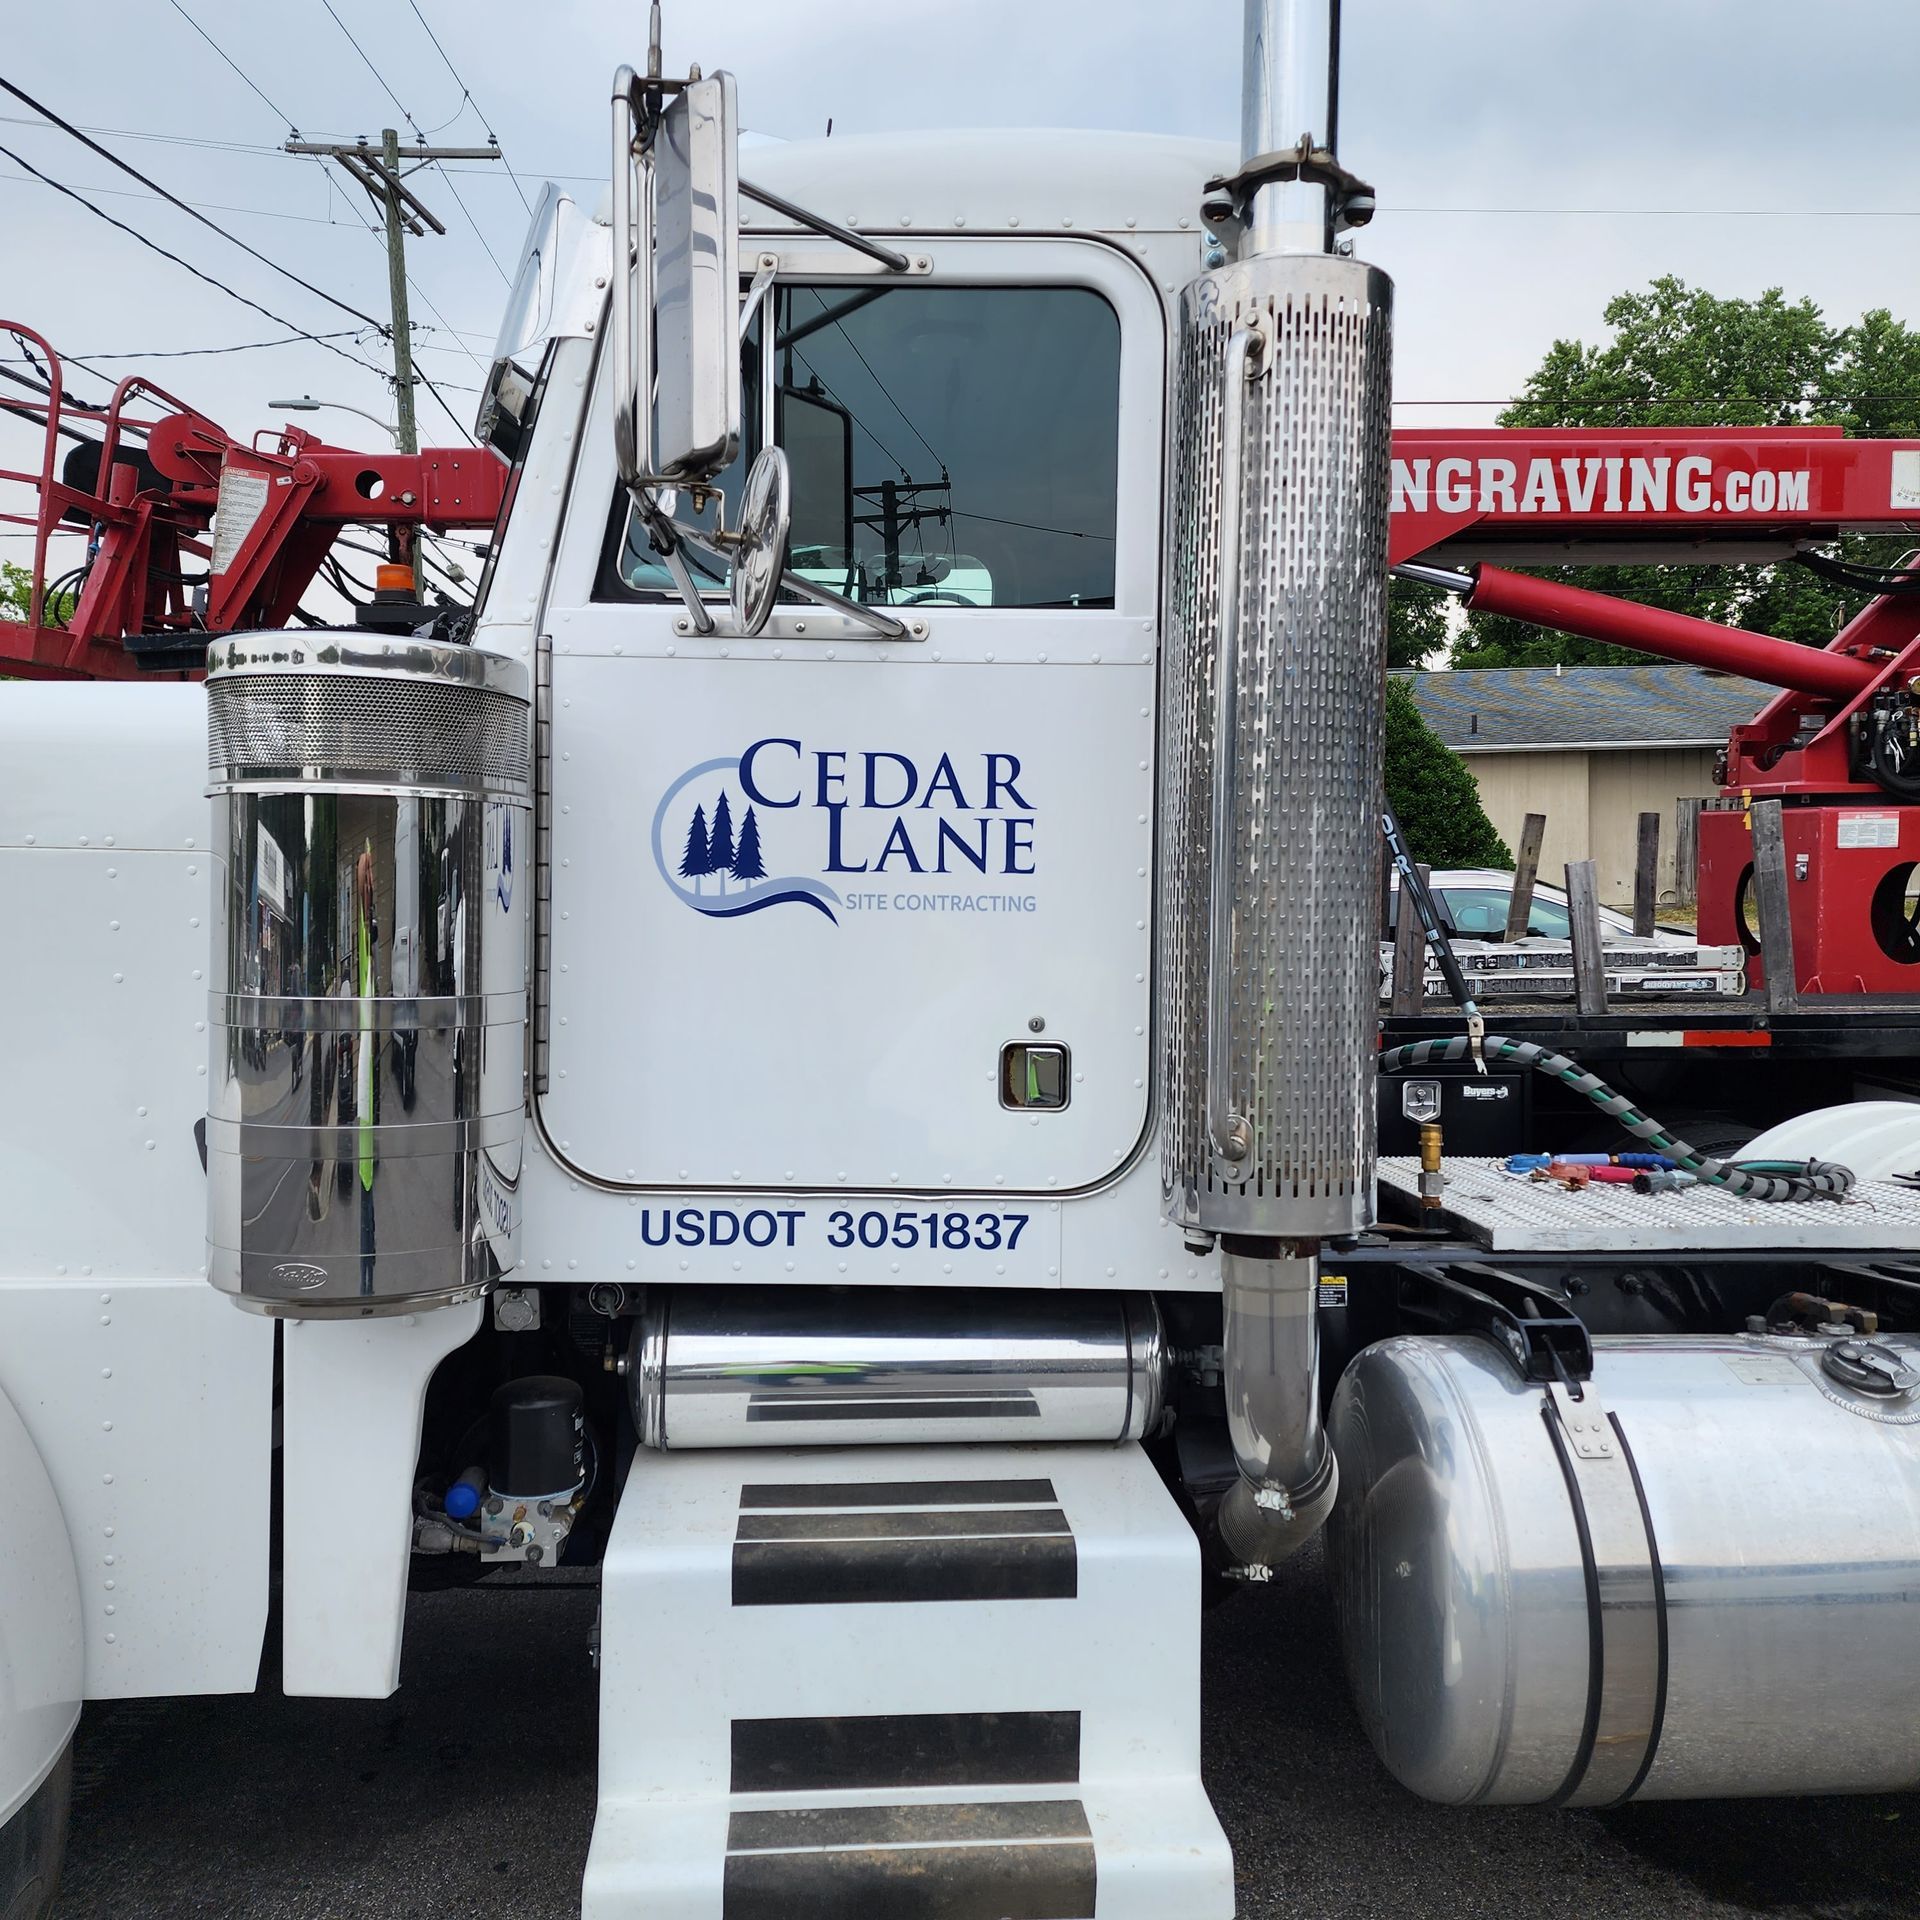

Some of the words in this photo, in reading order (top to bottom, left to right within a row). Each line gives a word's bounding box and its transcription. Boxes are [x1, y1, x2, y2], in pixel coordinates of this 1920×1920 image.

[738, 738, 1038, 810] CEDAR
[821, 805, 1037, 875] LANE
[845, 893, 888, 912] SITE
[892, 893, 1038, 914] CONTRACTING
[1463, 1085, 1496, 1097] Buyers
[641, 1208, 806, 1247] USDOT
[827, 1210, 1029, 1251] 3051837
